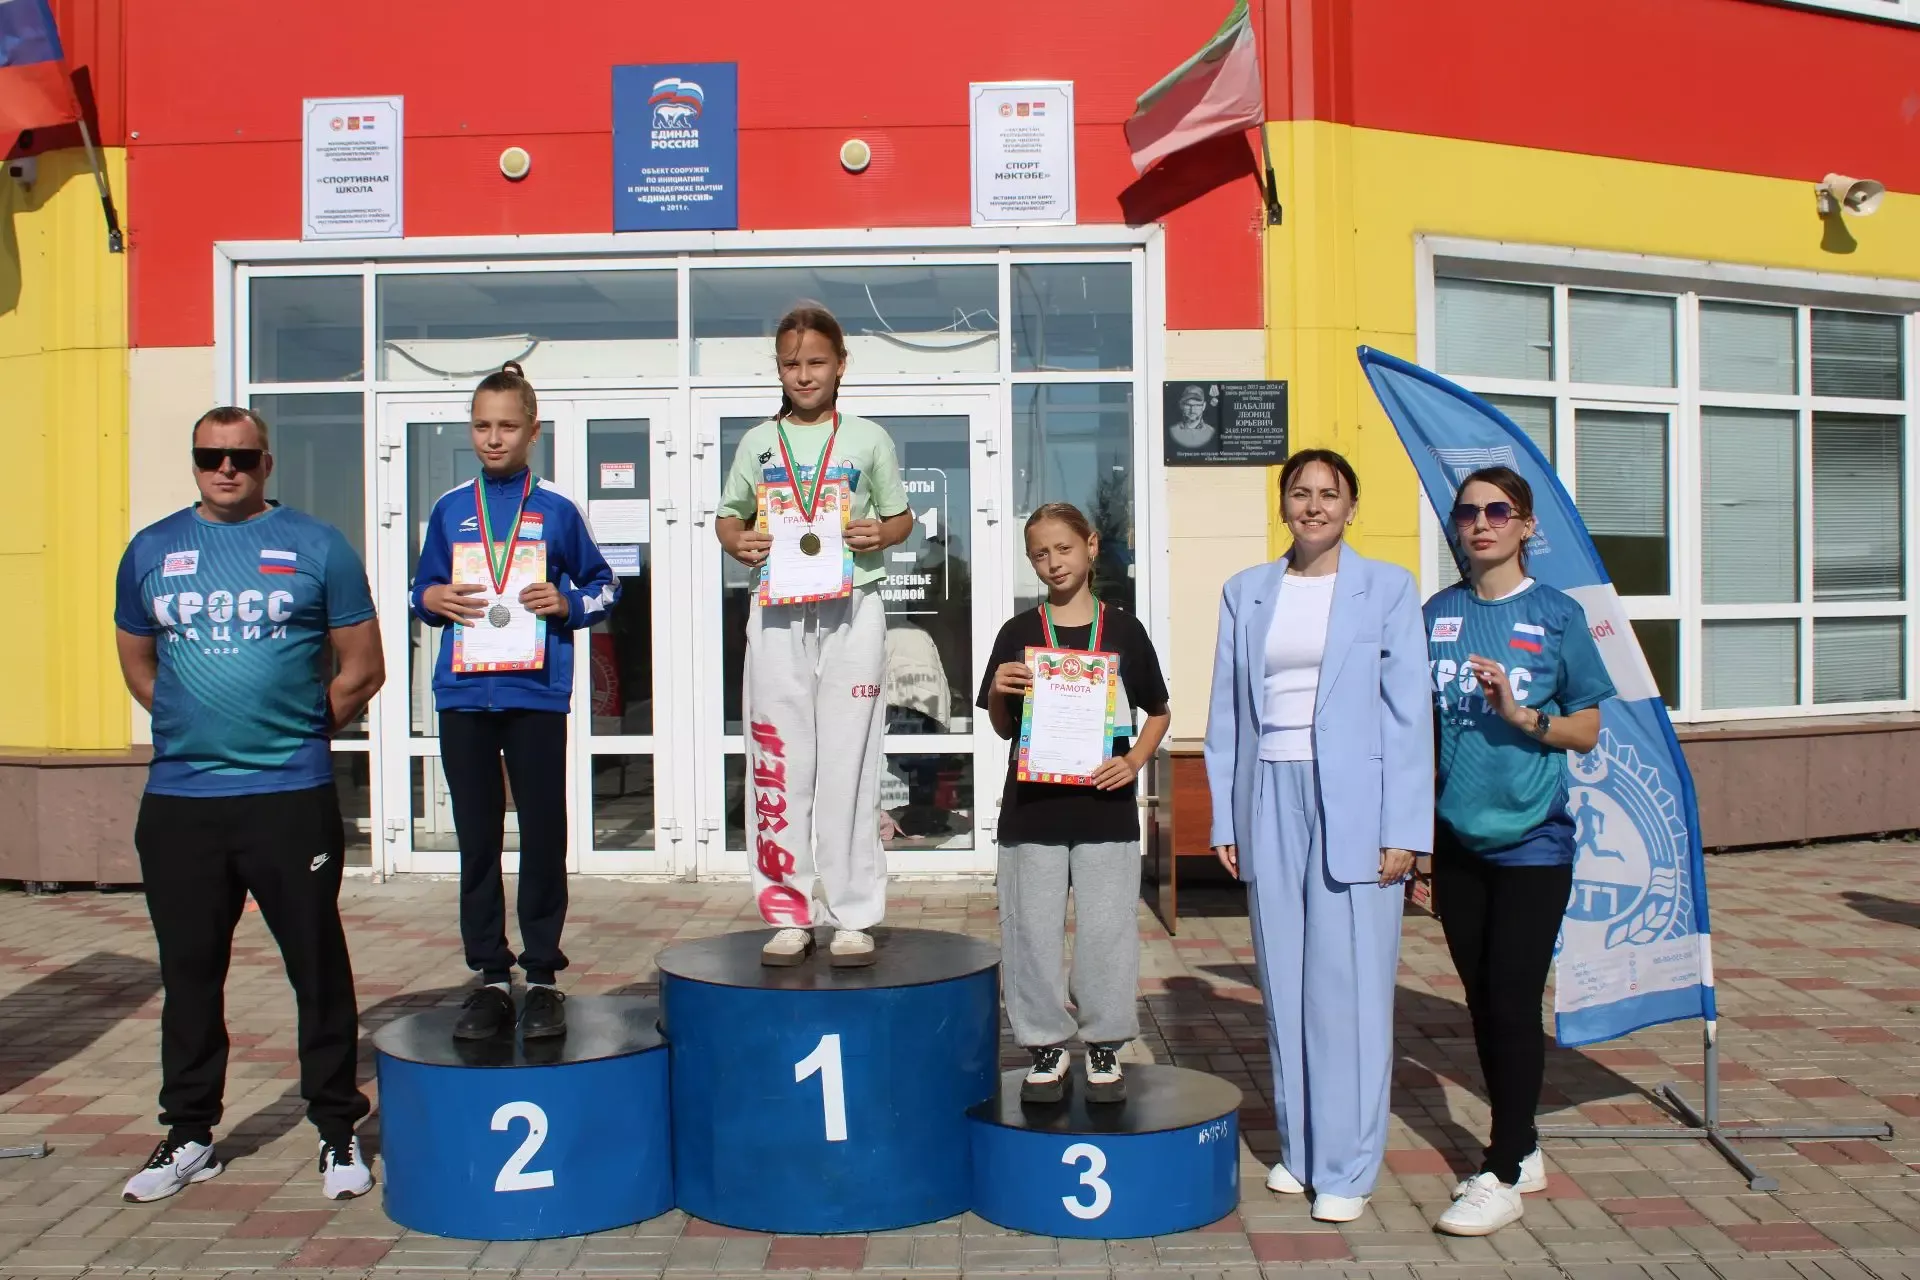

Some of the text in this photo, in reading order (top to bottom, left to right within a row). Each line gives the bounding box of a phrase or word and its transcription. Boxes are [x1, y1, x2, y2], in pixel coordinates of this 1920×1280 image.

[651, 129, 699, 140] ЕДИНАЯ
[651, 140, 699, 149] РОССИЯ
[641, 166, 710, 175] ОБЪЕКТ СООРУЖЕН
[1006, 162, 1040, 170] СПОРТ
[995, 172, 1051, 180] МӘКТӘБЕ»
[335, 186, 374, 194] ШКОЛА
[637, 193, 713, 203] «ЕДИНАЯ РОССИЯ»
[1233, 402, 1276, 410] ШАБАЛИН
[1238, 411, 1271, 419] ЛЕОНИД
[1235, 419, 1273, 427] ЮРЬЕВИЧ
[901, 480, 935, 493] БОТЫ
[878, 574, 932, 586] РЕСЕНЬЕ
[152, 589, 294, 627] КРОСС
[167, 625, 287, 643] НАЦИИ
[1430, 659, 1532, 700] РОС
[1050, 683, 1091, 694] ГРАМОТА
[794, 1033, 848, 1142] 1
[491, 1101, 555, 1192] 2
[1061, 1143, 1112, 1220] 3
